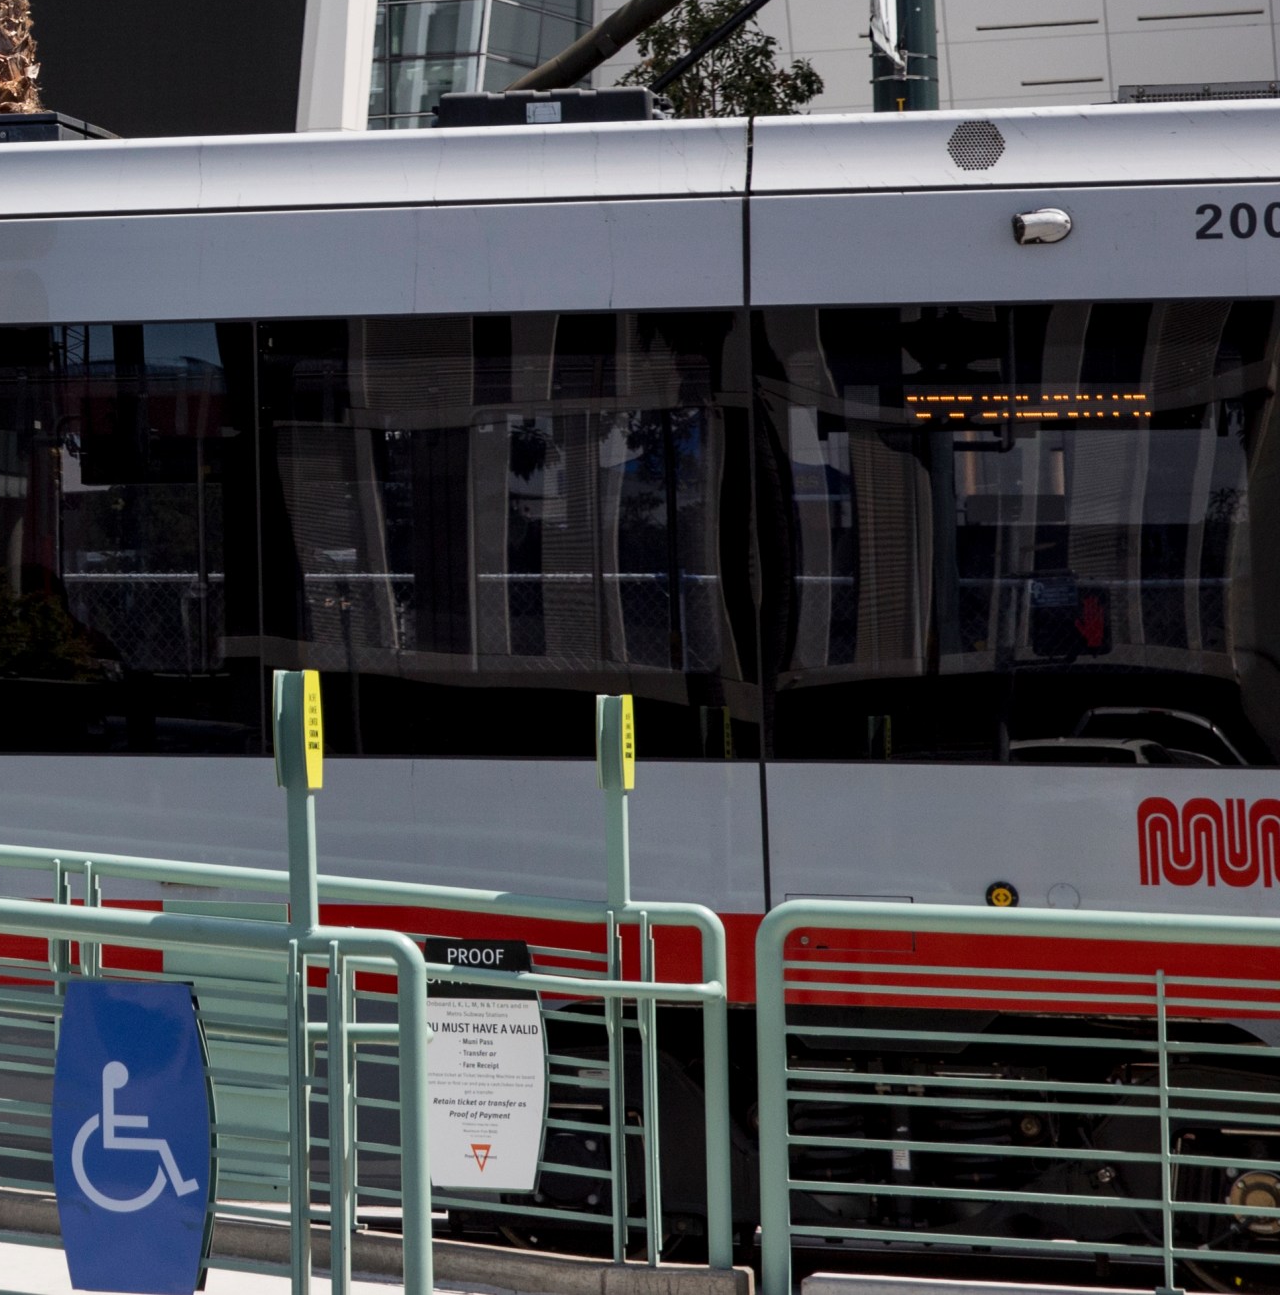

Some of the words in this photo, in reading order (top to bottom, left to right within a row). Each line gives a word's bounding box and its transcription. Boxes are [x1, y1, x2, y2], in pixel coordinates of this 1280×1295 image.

[447, 948, 504, 964] PROOF
[442, 1023, 470, 1033] MUST
[472, 1023, 498, 1034] HAVE
[500, 1024, 508, 1034] A
[509, 1025, 539, 1035] VALID
[477, 1062, 499, 1070] Receipt
[433, 1097, 456, 1105] Retain
[457, 1098, 477, 1106] ticket
[487, 1100, 516, 1108] transfer
[449, 1110, 469, 1119] Proof
[470, 1111, 477, 1119] of
[479, 1111, 510, 1120] Payment
